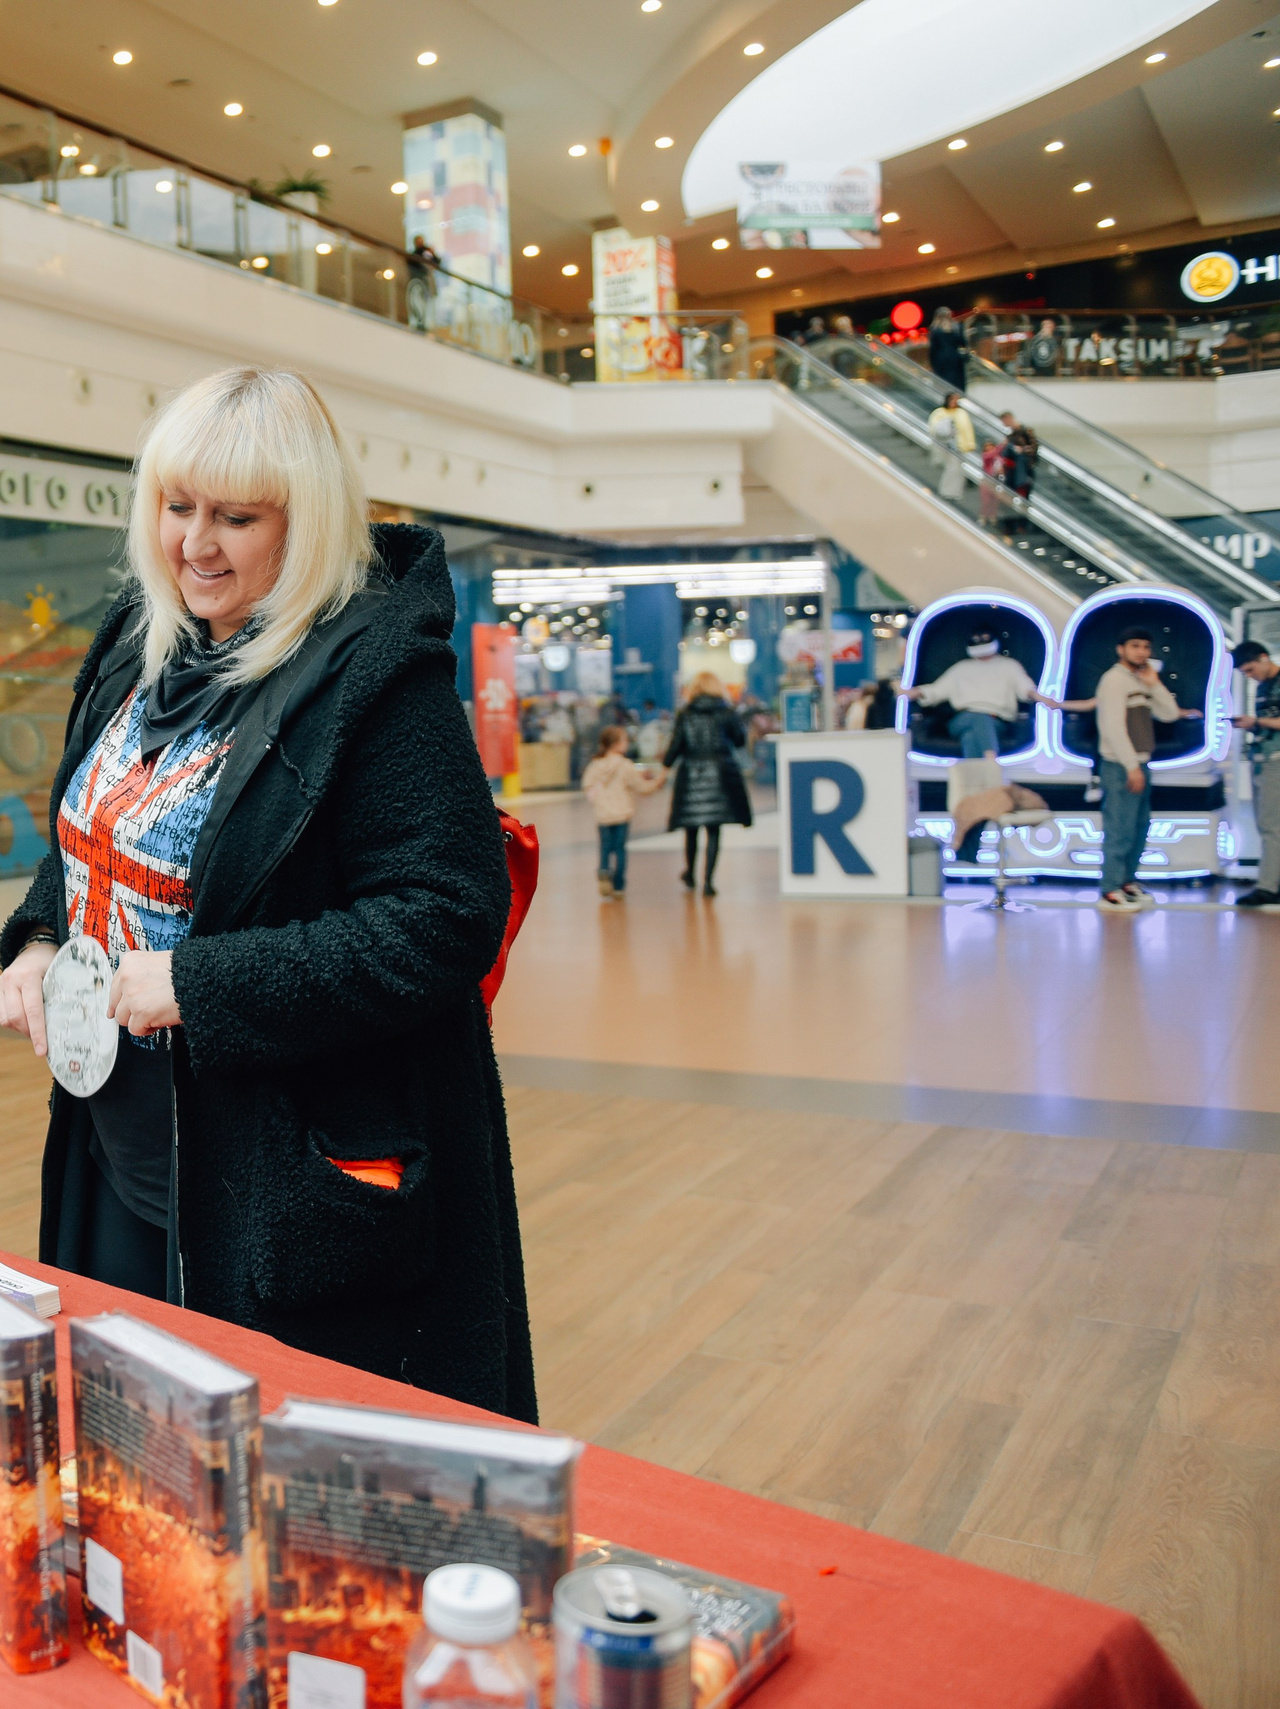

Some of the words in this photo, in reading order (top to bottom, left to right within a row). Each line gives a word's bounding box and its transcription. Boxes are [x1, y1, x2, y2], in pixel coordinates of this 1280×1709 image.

[1063, 337, 1171, 362] TAKSIM
[789, 759, 876, 876] R
[125, 835, 162, 860] woman
